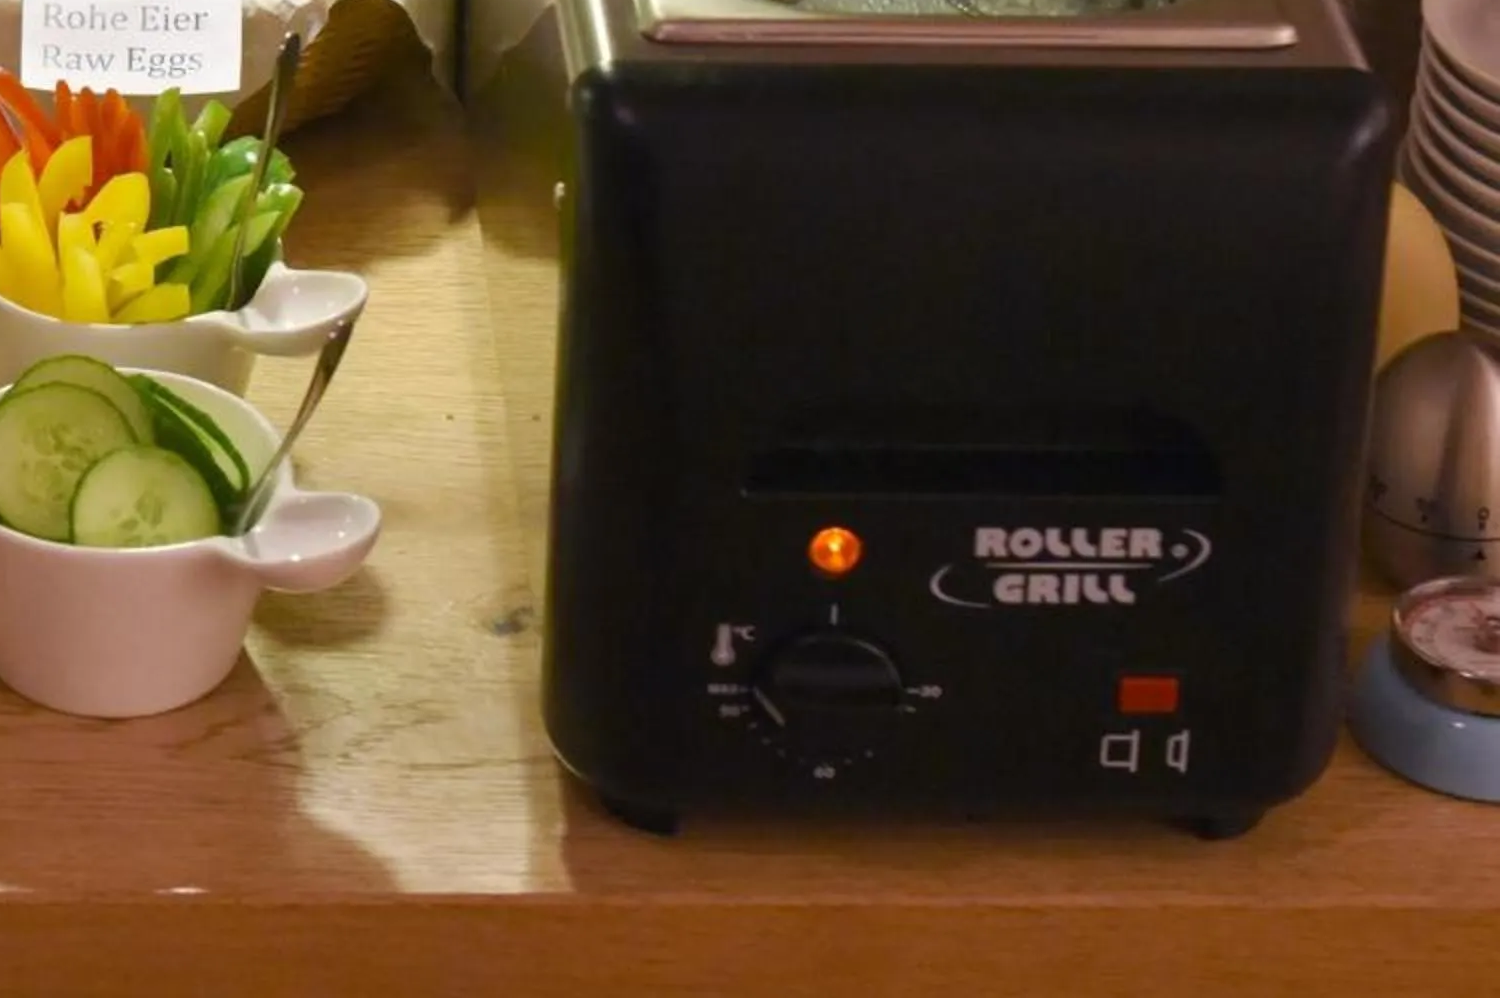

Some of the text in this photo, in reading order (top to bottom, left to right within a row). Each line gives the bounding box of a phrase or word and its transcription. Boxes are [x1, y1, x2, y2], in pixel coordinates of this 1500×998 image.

[43, 3, 209, 32] Rohe Eier
[41, 44, 204, 79] Raw Eggs
[974, 527, 1163, 559] ROLLER
[993, 573, 1136, 604] GRILL
